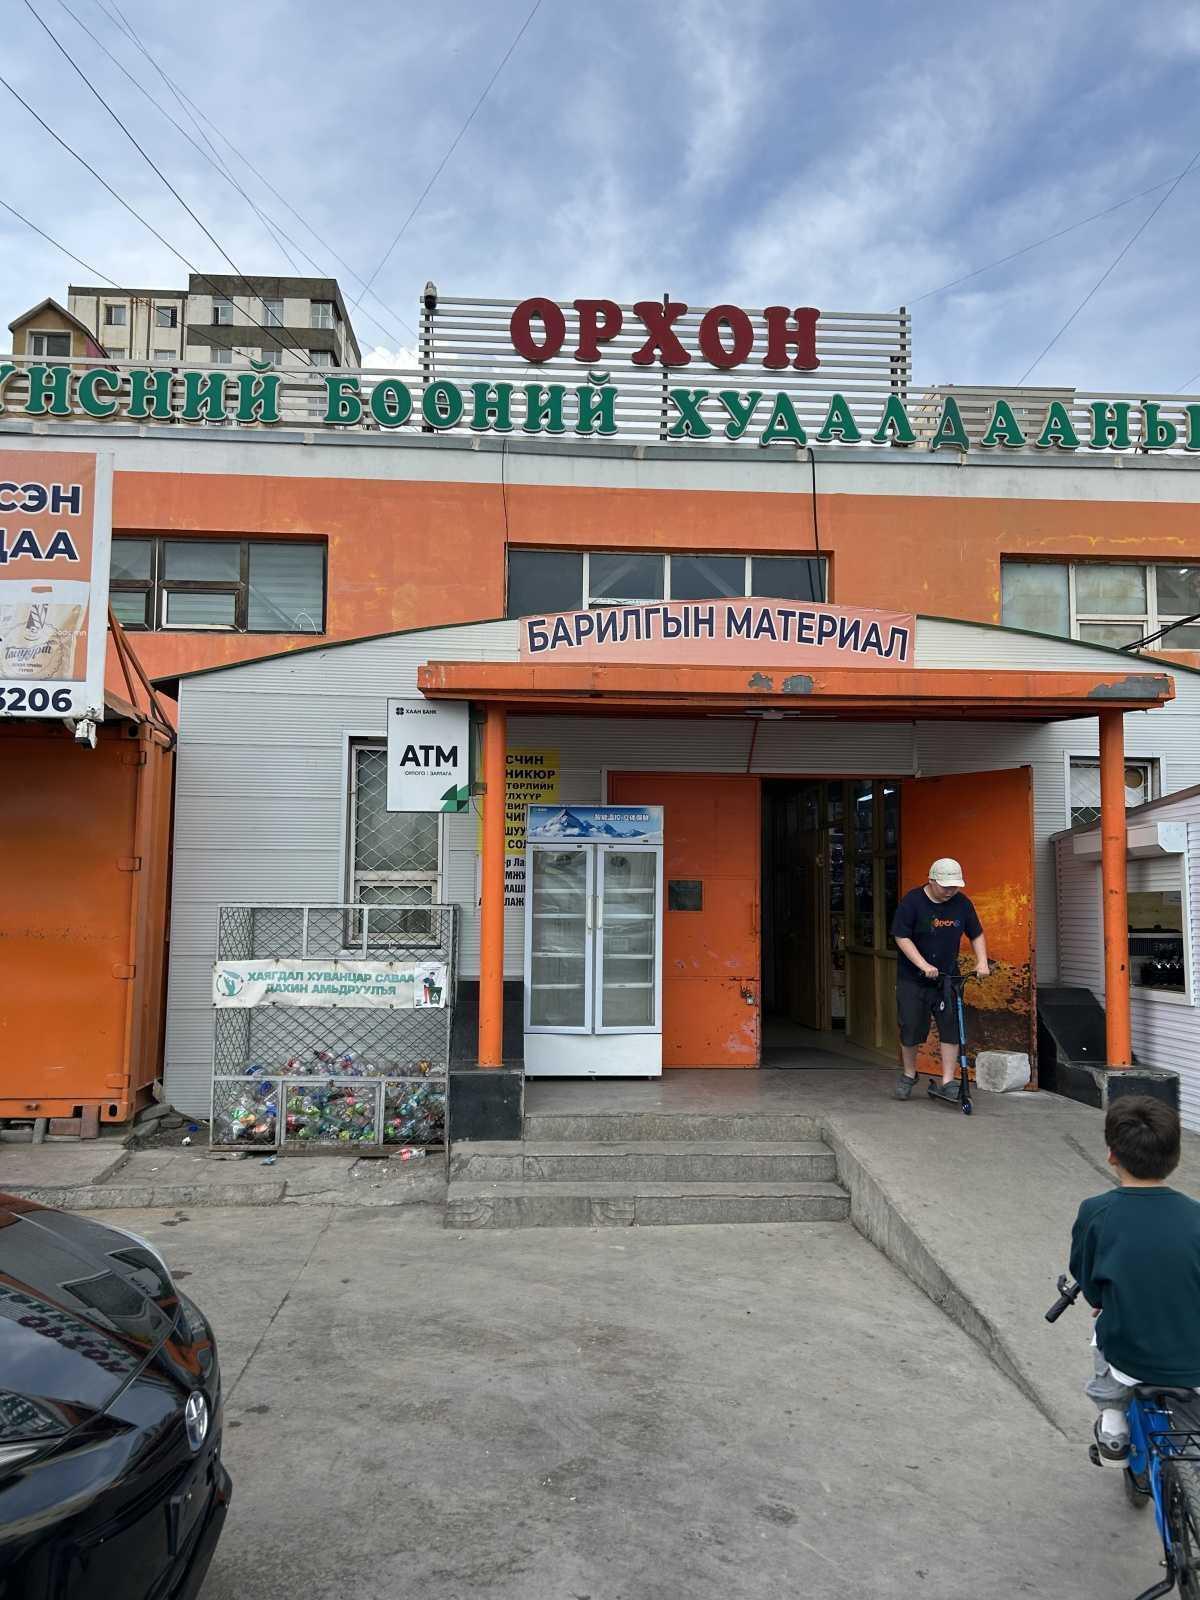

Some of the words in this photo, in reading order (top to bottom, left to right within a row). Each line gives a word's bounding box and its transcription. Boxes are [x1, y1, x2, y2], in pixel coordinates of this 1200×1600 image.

[510, 297, 821, 370] ОРХОН
[322, 371, 619, 436] БӨӨНИЙ
[668, 389, 1200, 452] ХУДАЛДААНЫ
[527, 606, 714, 653] БАРИЛГЫН
[726, 607, 909, 660] МАТЕРИАЛ
[399, 744, 458, 767] ATM
[248, 971, 304, 982] ХАЯГДАЛ
[307, 972, 372, 983] ХУВАНЦАР
[375, 974, 415, 984] САВАА
[265, 984, 308, 994] ДАХИН
